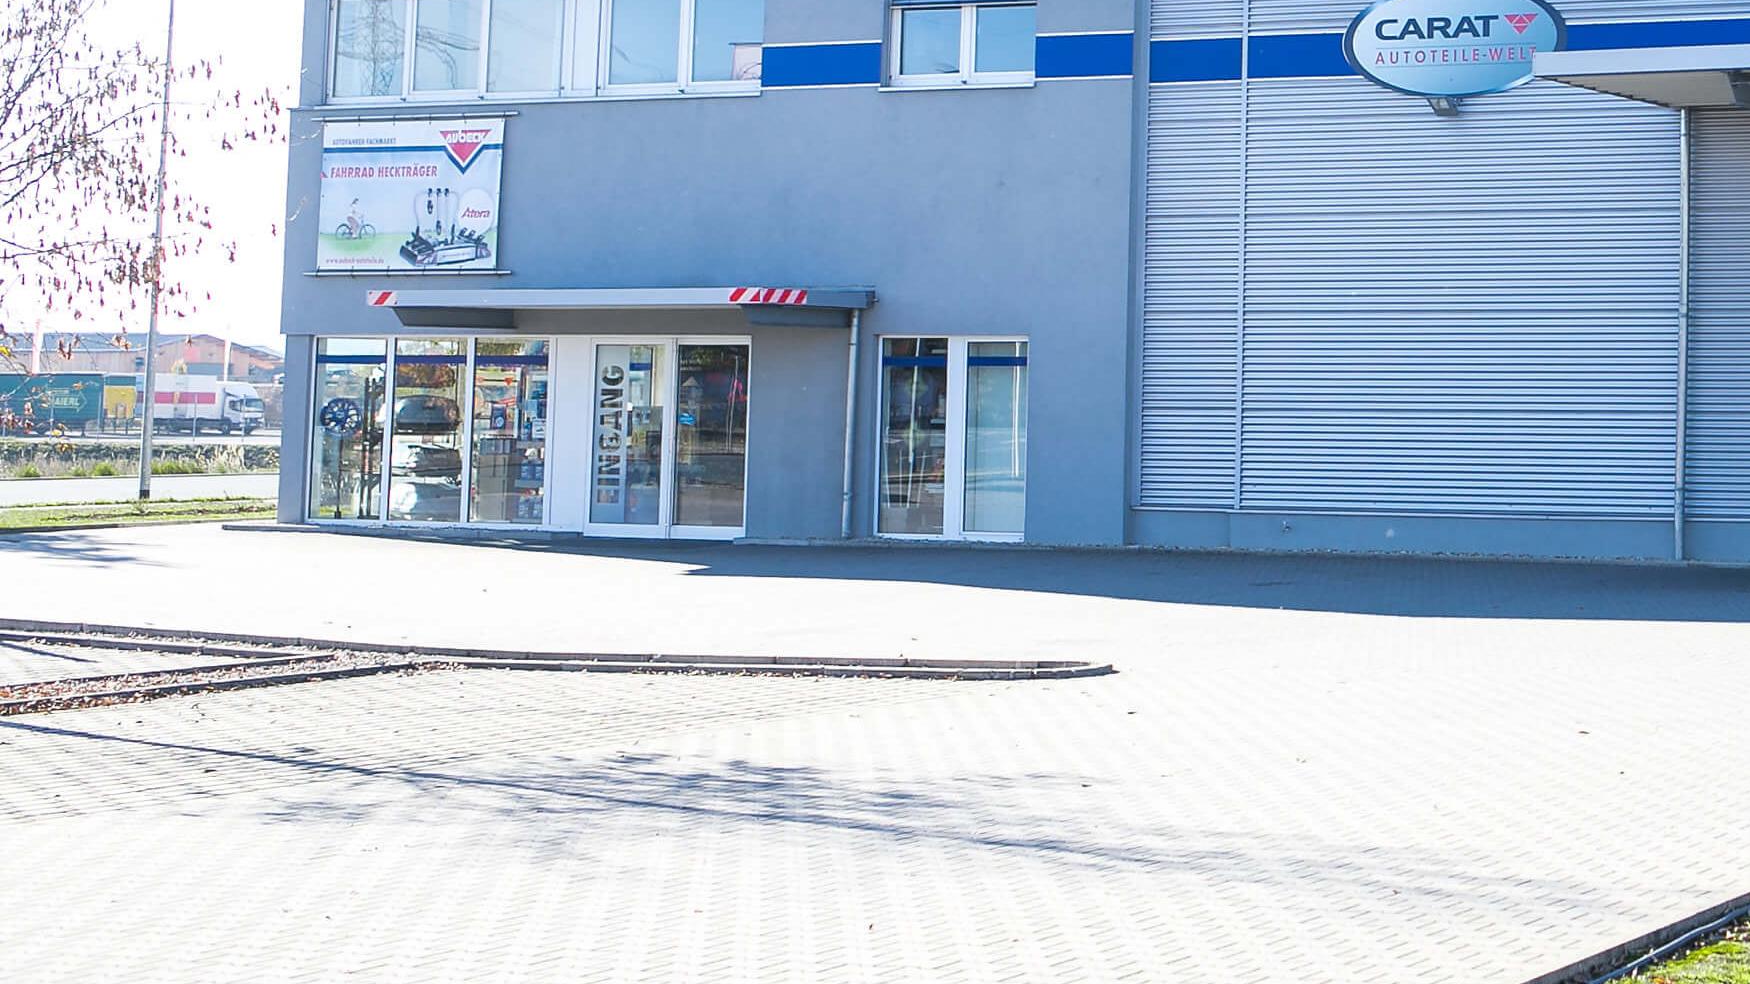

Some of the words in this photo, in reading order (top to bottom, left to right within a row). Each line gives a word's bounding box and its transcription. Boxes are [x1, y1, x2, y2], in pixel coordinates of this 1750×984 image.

[1375, 15, 1499, 41] CARAT
[330, 166, 375, 179] FAHRRAD
[378, 162, 438, 178] HECKTRÄGER
[597, 364, 625, 504] EINGANG
